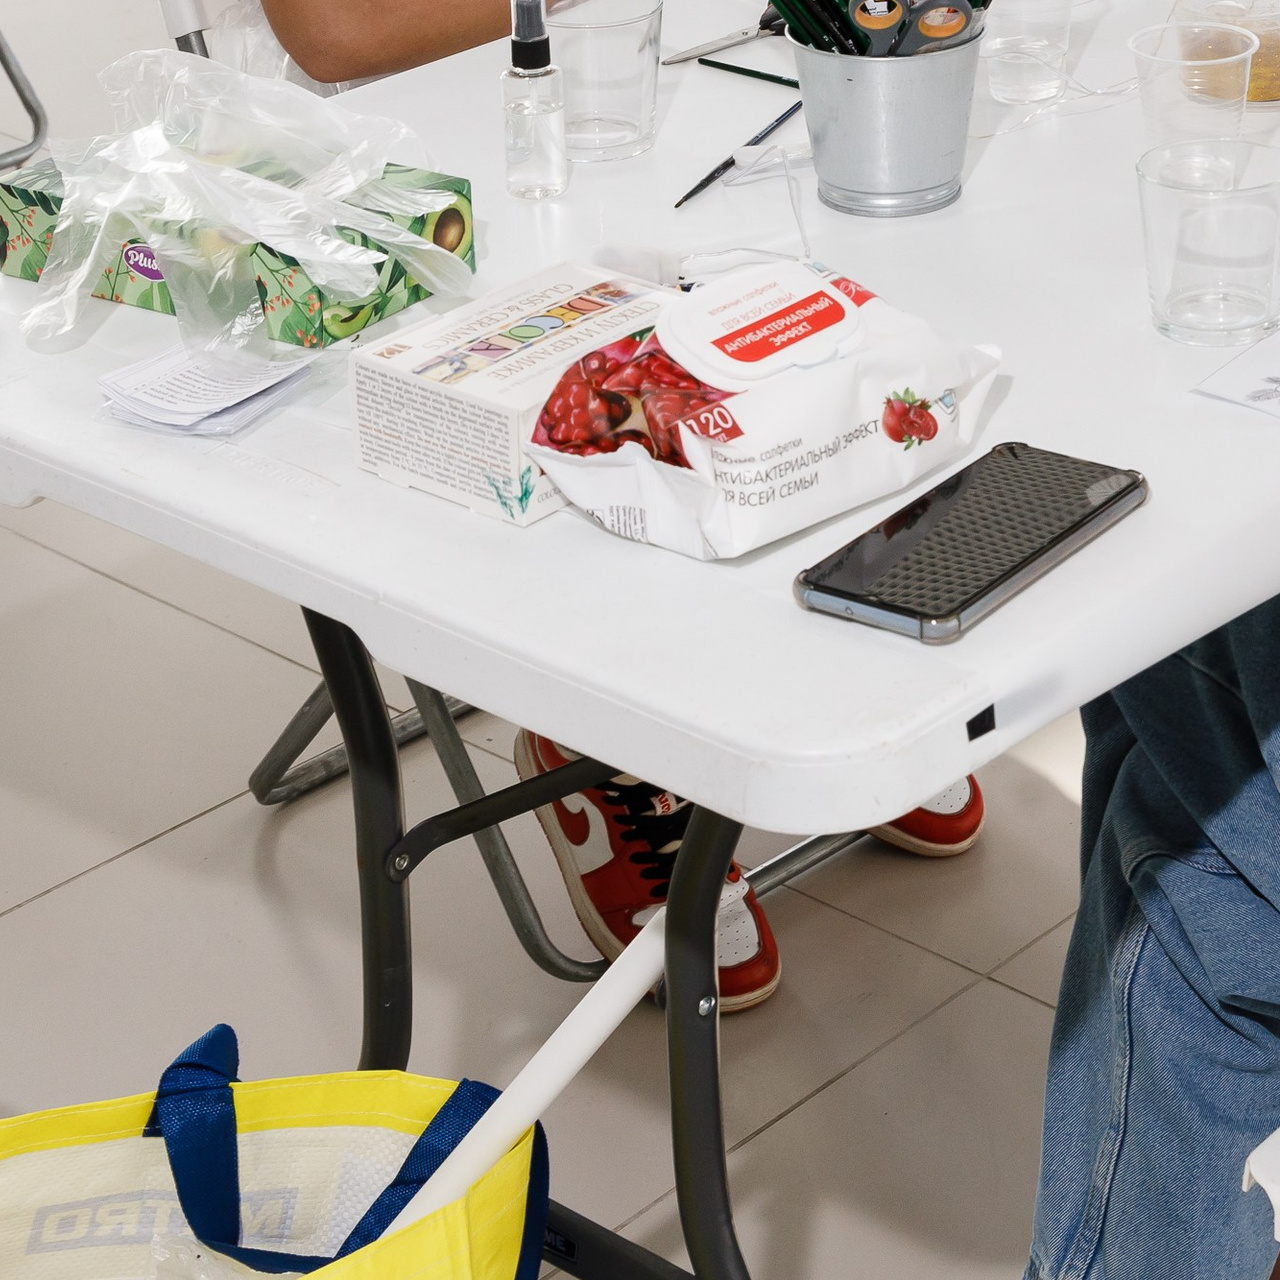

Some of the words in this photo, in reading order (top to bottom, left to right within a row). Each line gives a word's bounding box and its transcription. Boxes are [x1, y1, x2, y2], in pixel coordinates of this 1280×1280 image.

[128, 250, 159, 271] Plus
[520, 282, 574, 308] GLASS
[421, 312, 511, 351] CERAMICS
[468, 297, 607, 353] DECOLA
[724, 296, 834, 354] АНТИБАКТЕРИАЛЬНЫЙ
[768, 321, 812, 347] ЭФФЕКТ
[486, 335, 583, 381] КЕРАМИКЕ
[685, 406, 733, 436] 120
[714, 436, 842, 486] НТИБАКТЕРИАЛЬНЫЙ
[843, 419, 880, 449] ЭФФЕКТ
[760, 437, 803, 463] салфетки
[738, 486, 776, 507] ВСЕЙ
[779, 471, 819, 498] СЕМЬИ
